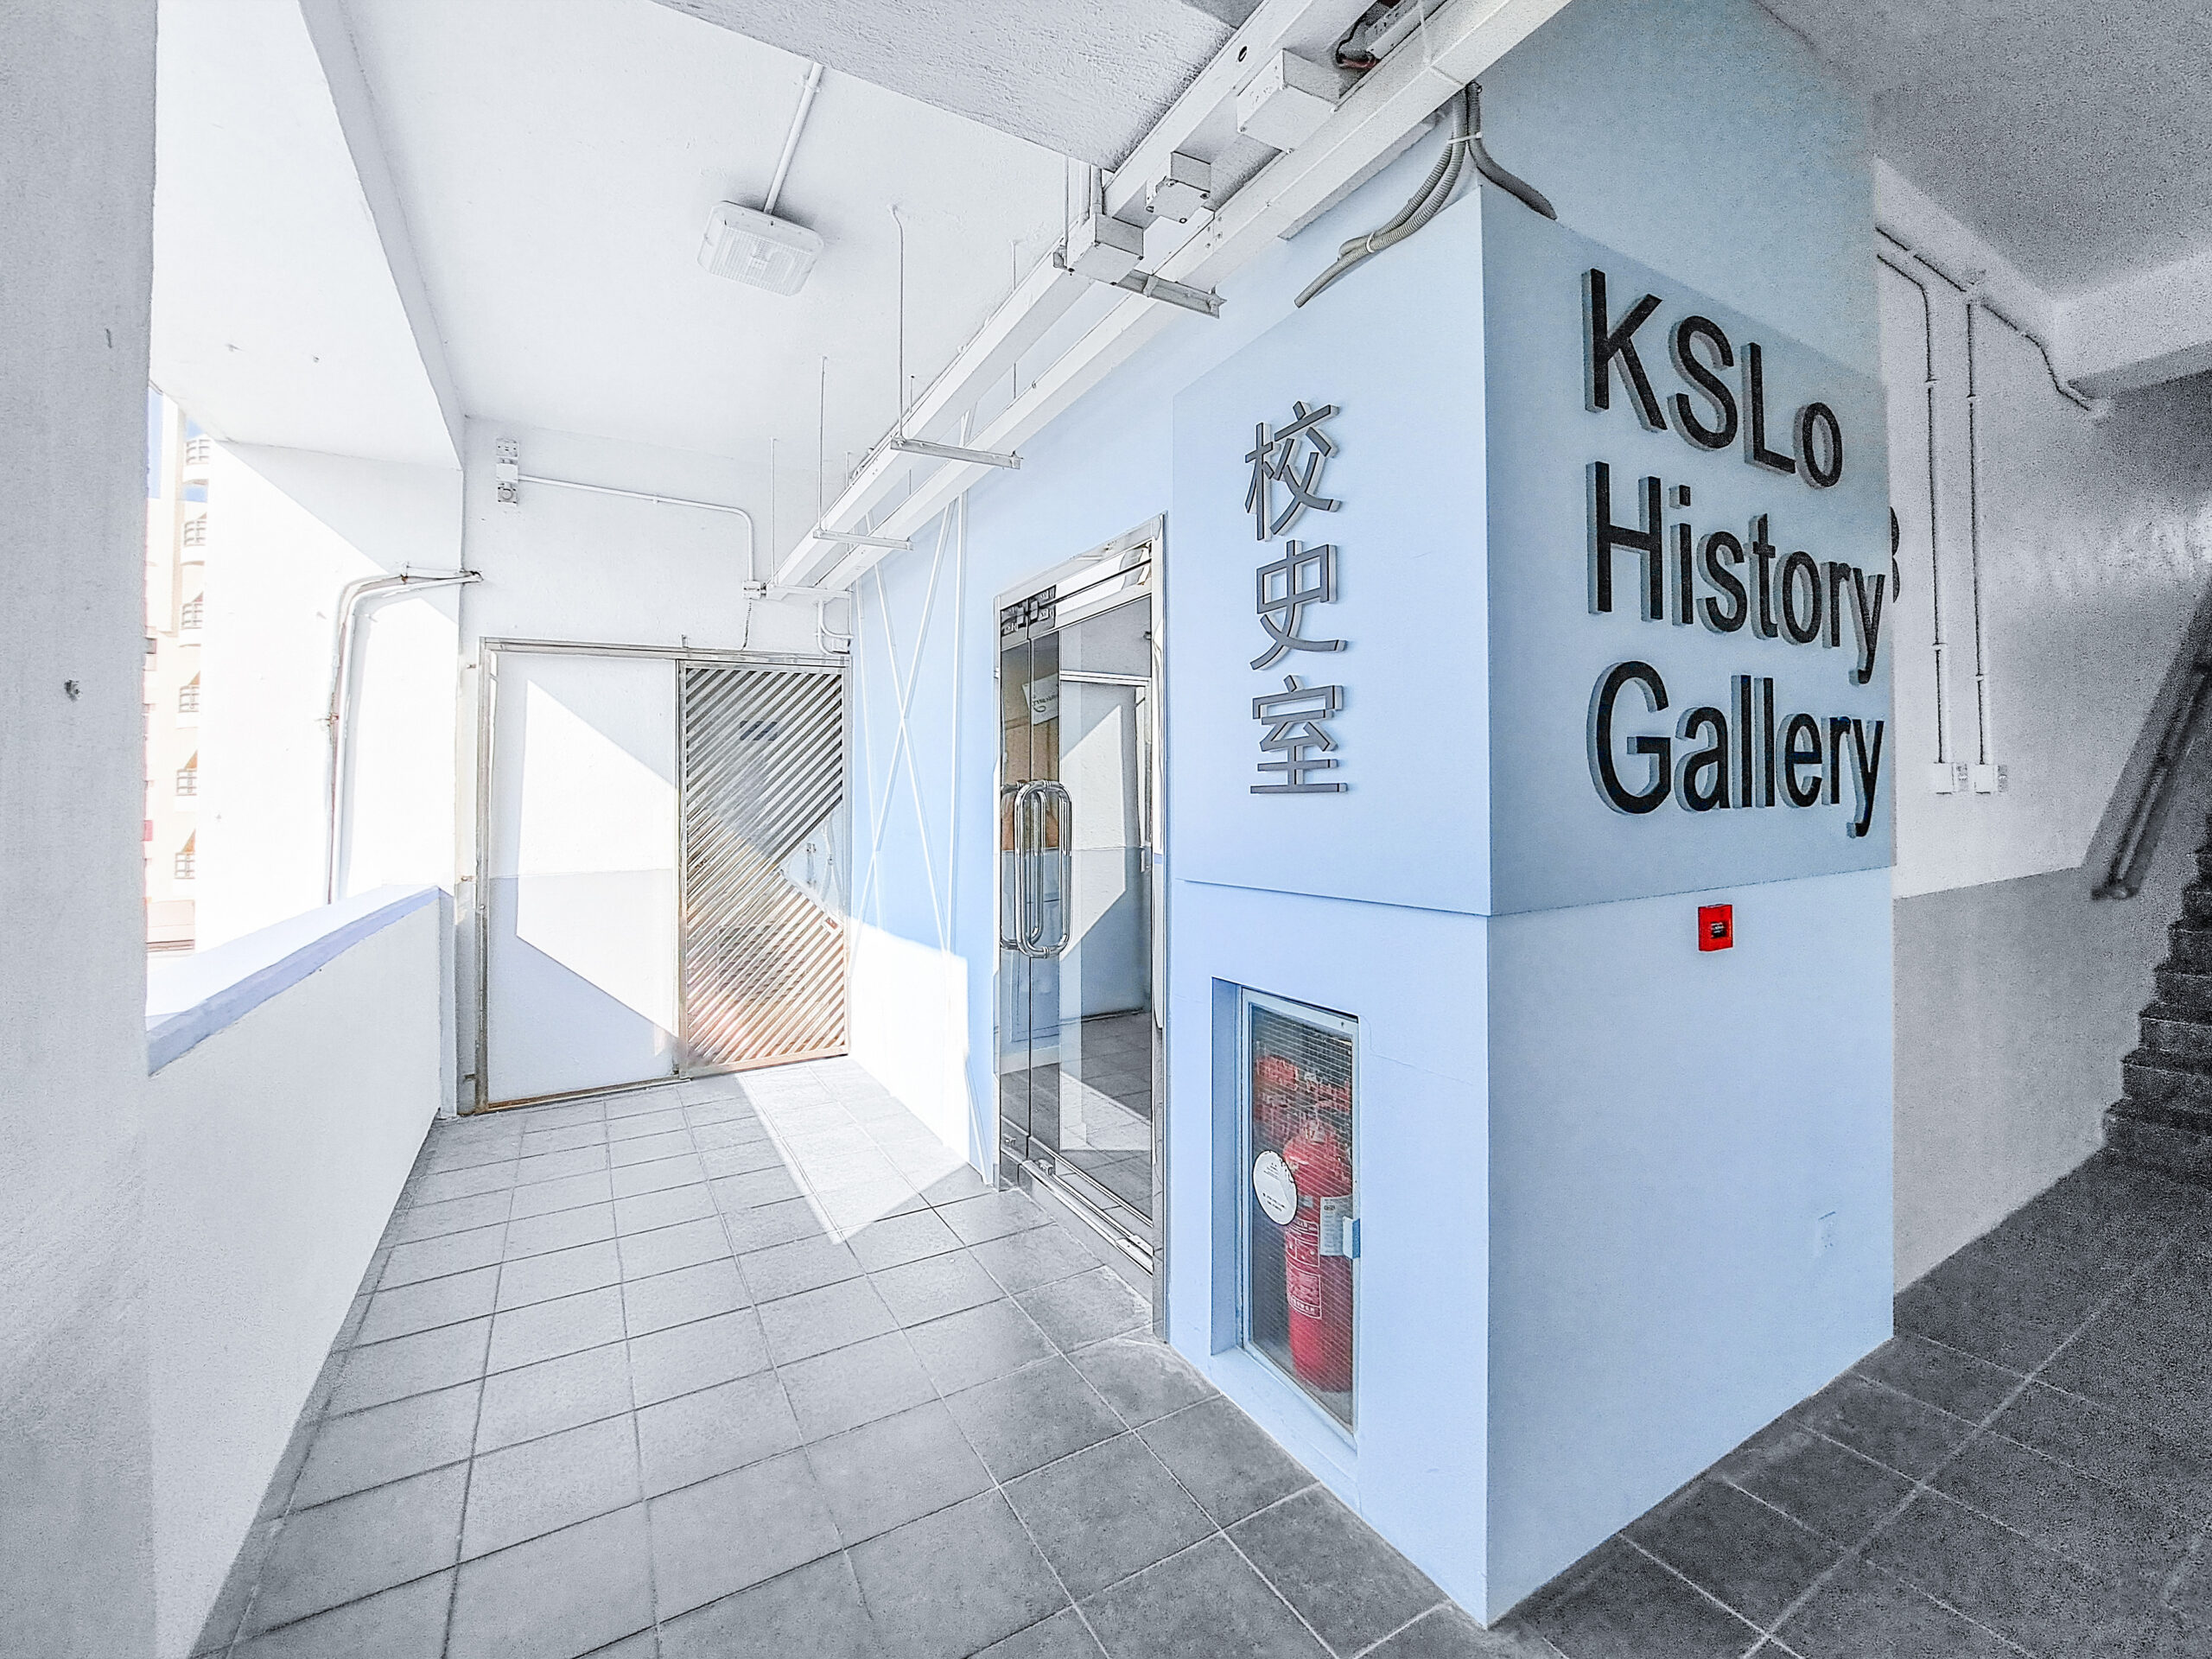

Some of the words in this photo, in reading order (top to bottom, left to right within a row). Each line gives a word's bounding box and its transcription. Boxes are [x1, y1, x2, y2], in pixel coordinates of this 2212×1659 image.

[1583, 268, 1843, 489] KSLo
[1244, 400, 1348, 794] 校史室
[1586, 461, 1886, 685] History
[1587, 660, 1885, 837] Gallery
